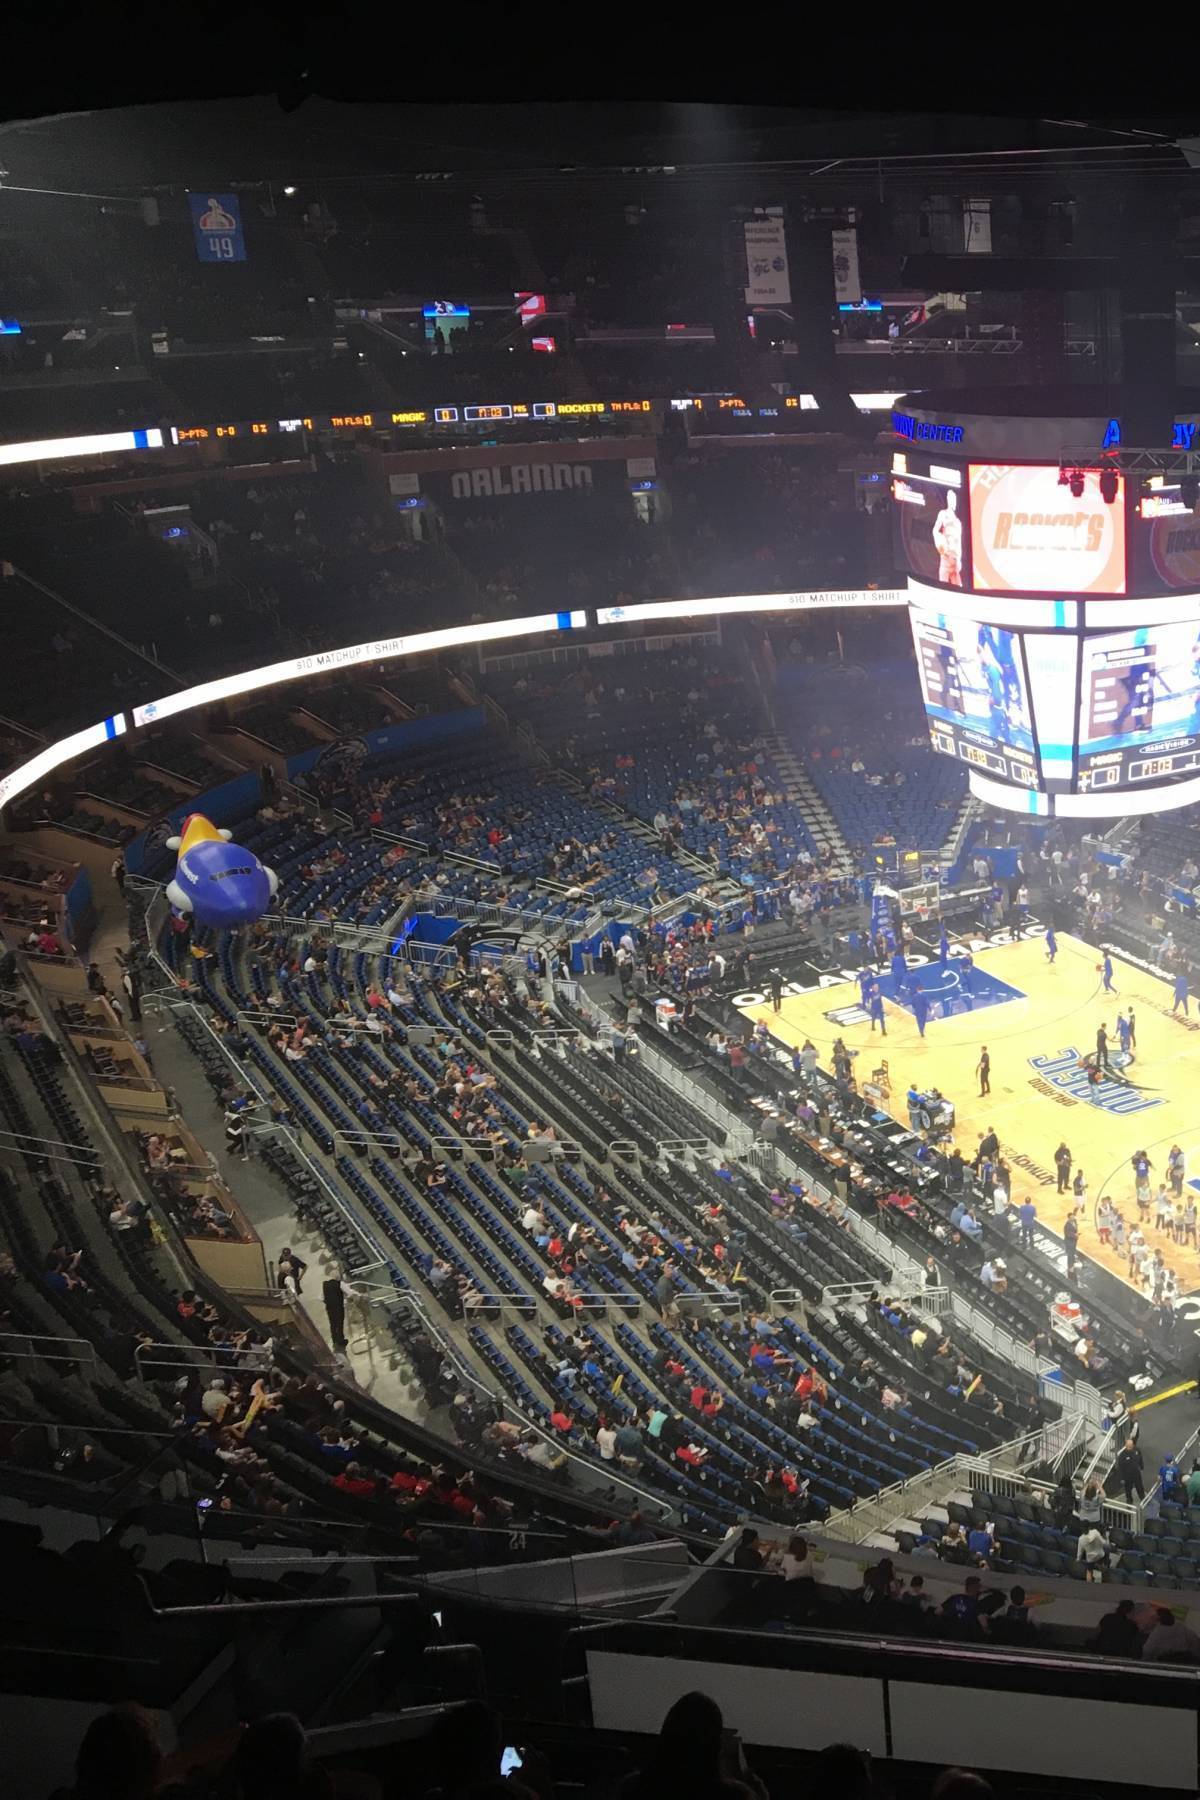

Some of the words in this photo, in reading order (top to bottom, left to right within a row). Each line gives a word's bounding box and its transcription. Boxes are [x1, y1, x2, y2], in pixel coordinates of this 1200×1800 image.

[209, 237, 234, 258] 49
[392, 411, 426, 423] MAGIC
[557, 403, 605, 414] ROCKETS
[916, 422, 963, 443] CENTER
[450, 462, 593, 498] ORLANDO
[809, 593, 858, 603] MATCHUP
[316, 648, 361, 666] MATCHUP
[1027, 1077, 1079, 1107] ORLANDO
